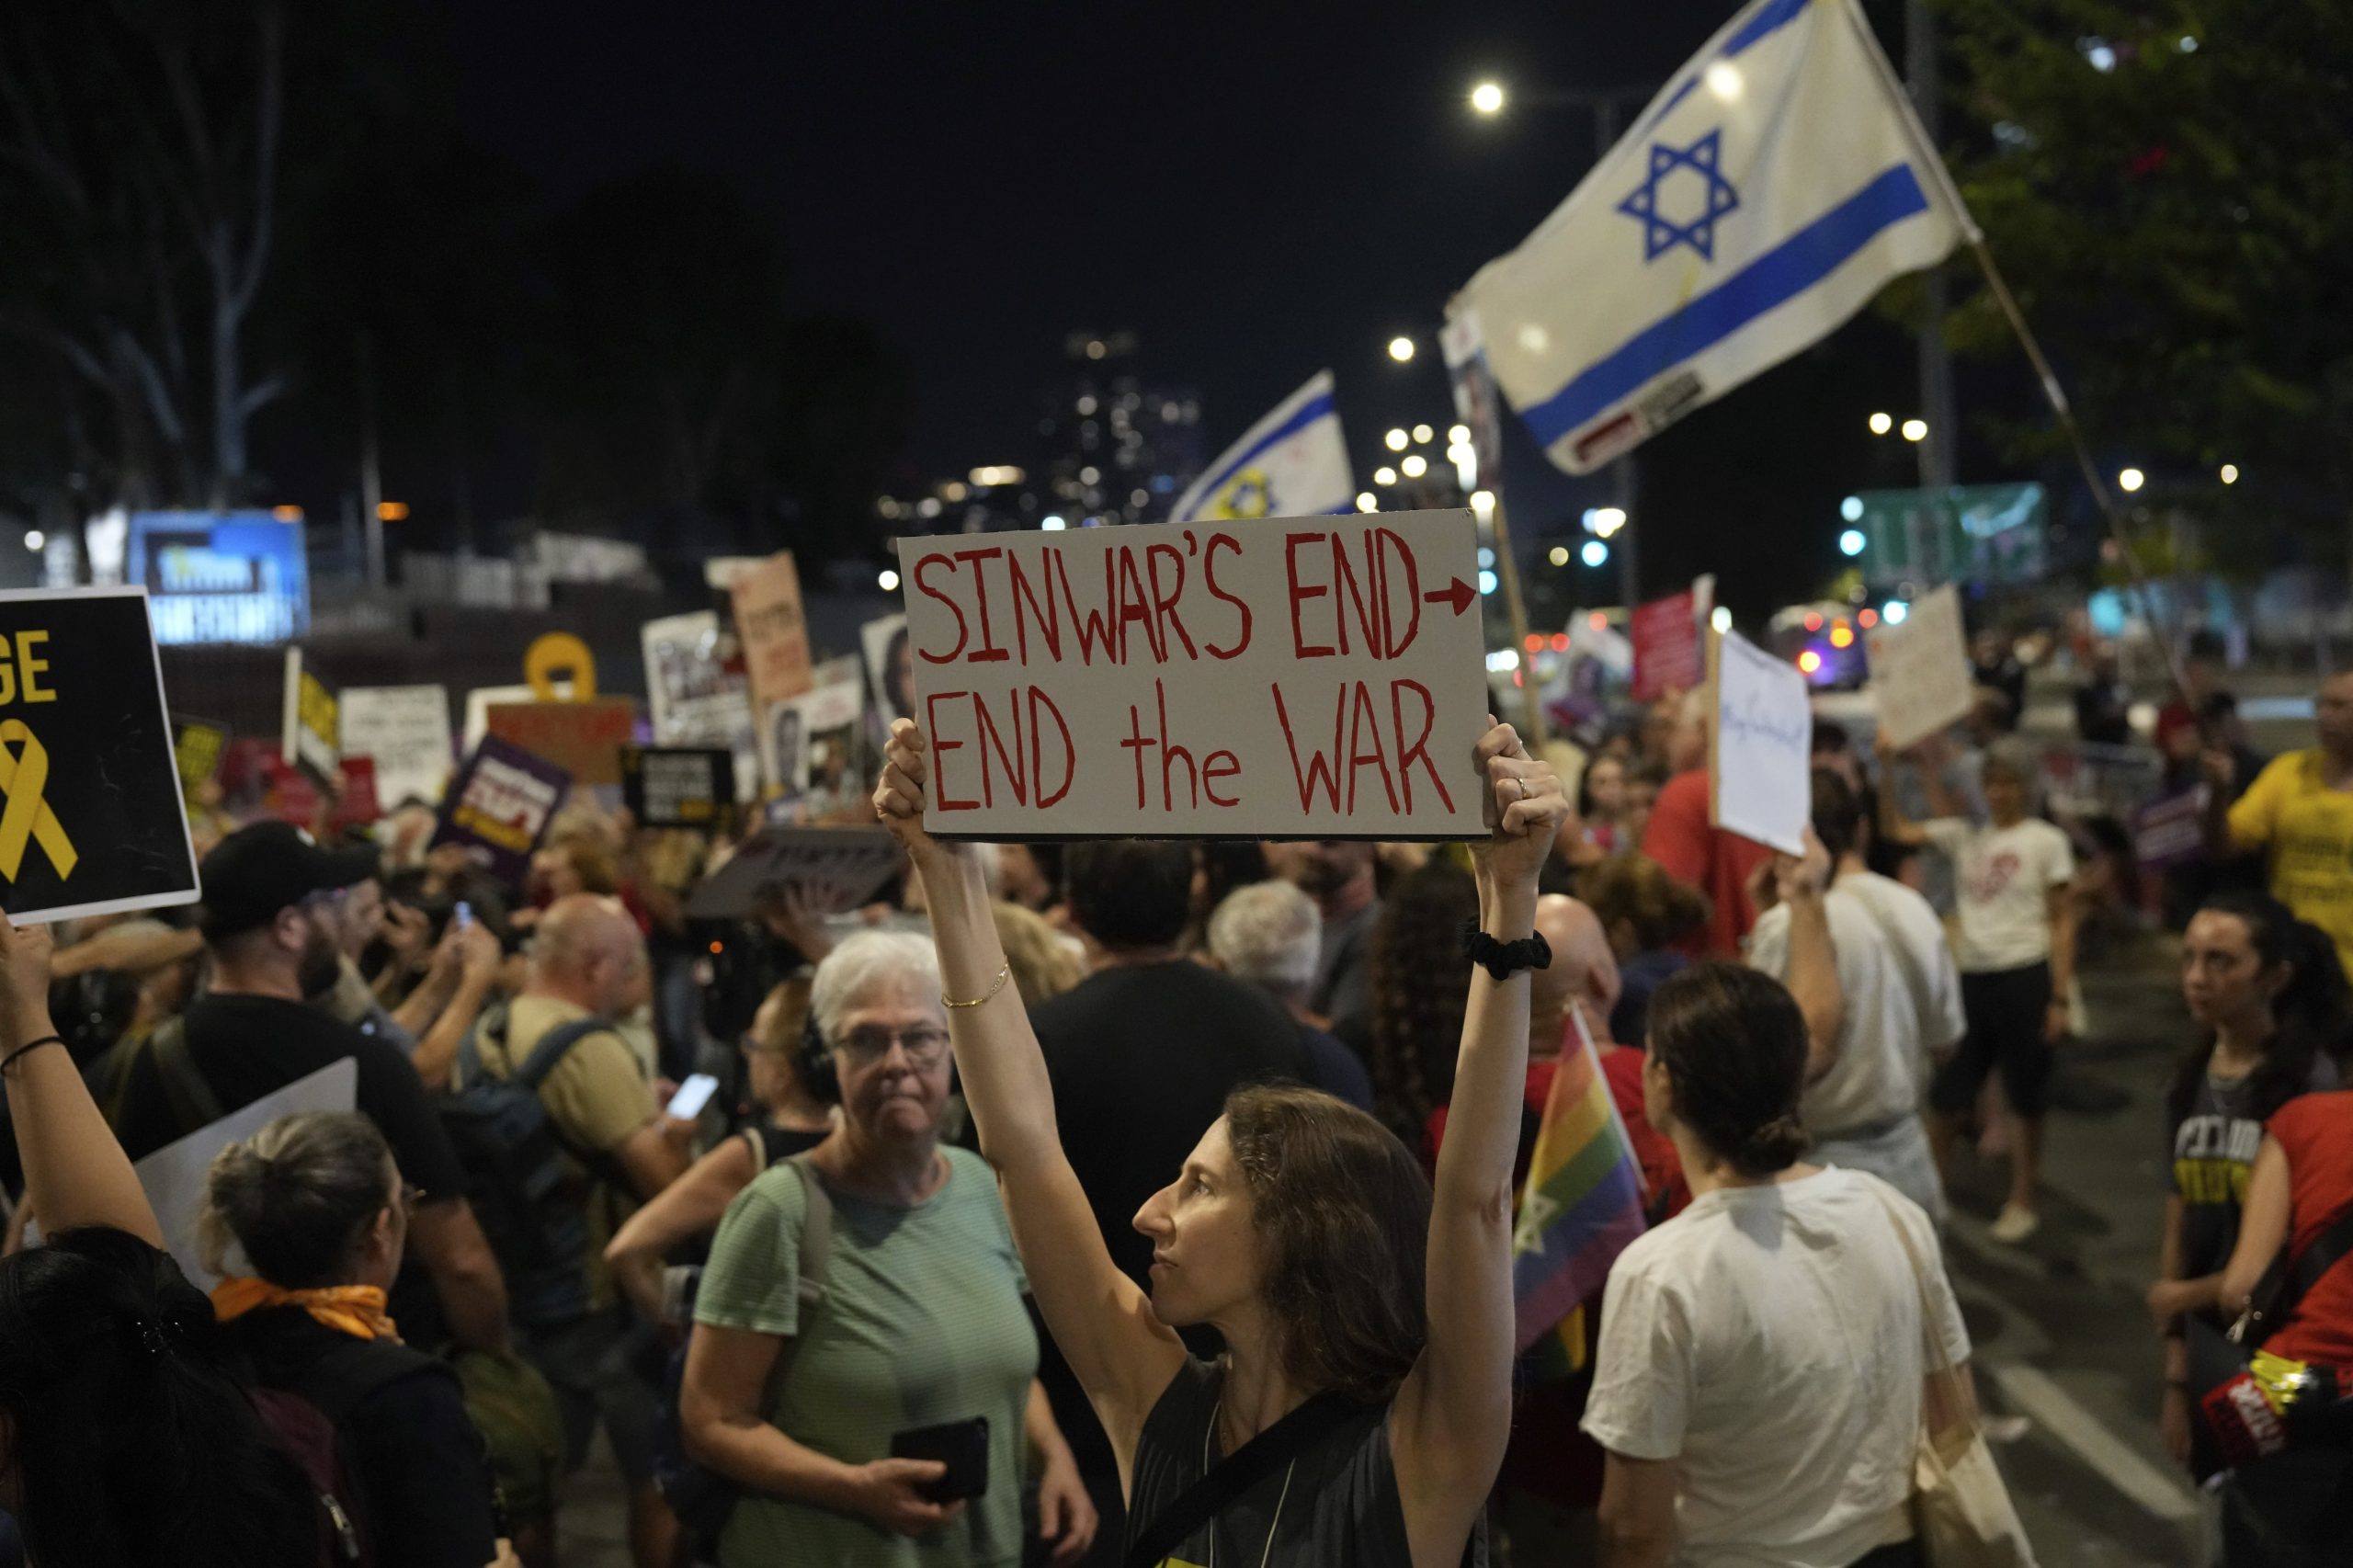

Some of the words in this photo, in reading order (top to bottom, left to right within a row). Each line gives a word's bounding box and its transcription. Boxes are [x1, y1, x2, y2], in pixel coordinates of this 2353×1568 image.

[914, 529, 1253, 666] SINWAR'S
[1285, 527, 1421, 661] END
[926, 685, 1075, 812] END
[1120, 677, 1242, 812] the
[1271, 678, 1456, 816] WAR
